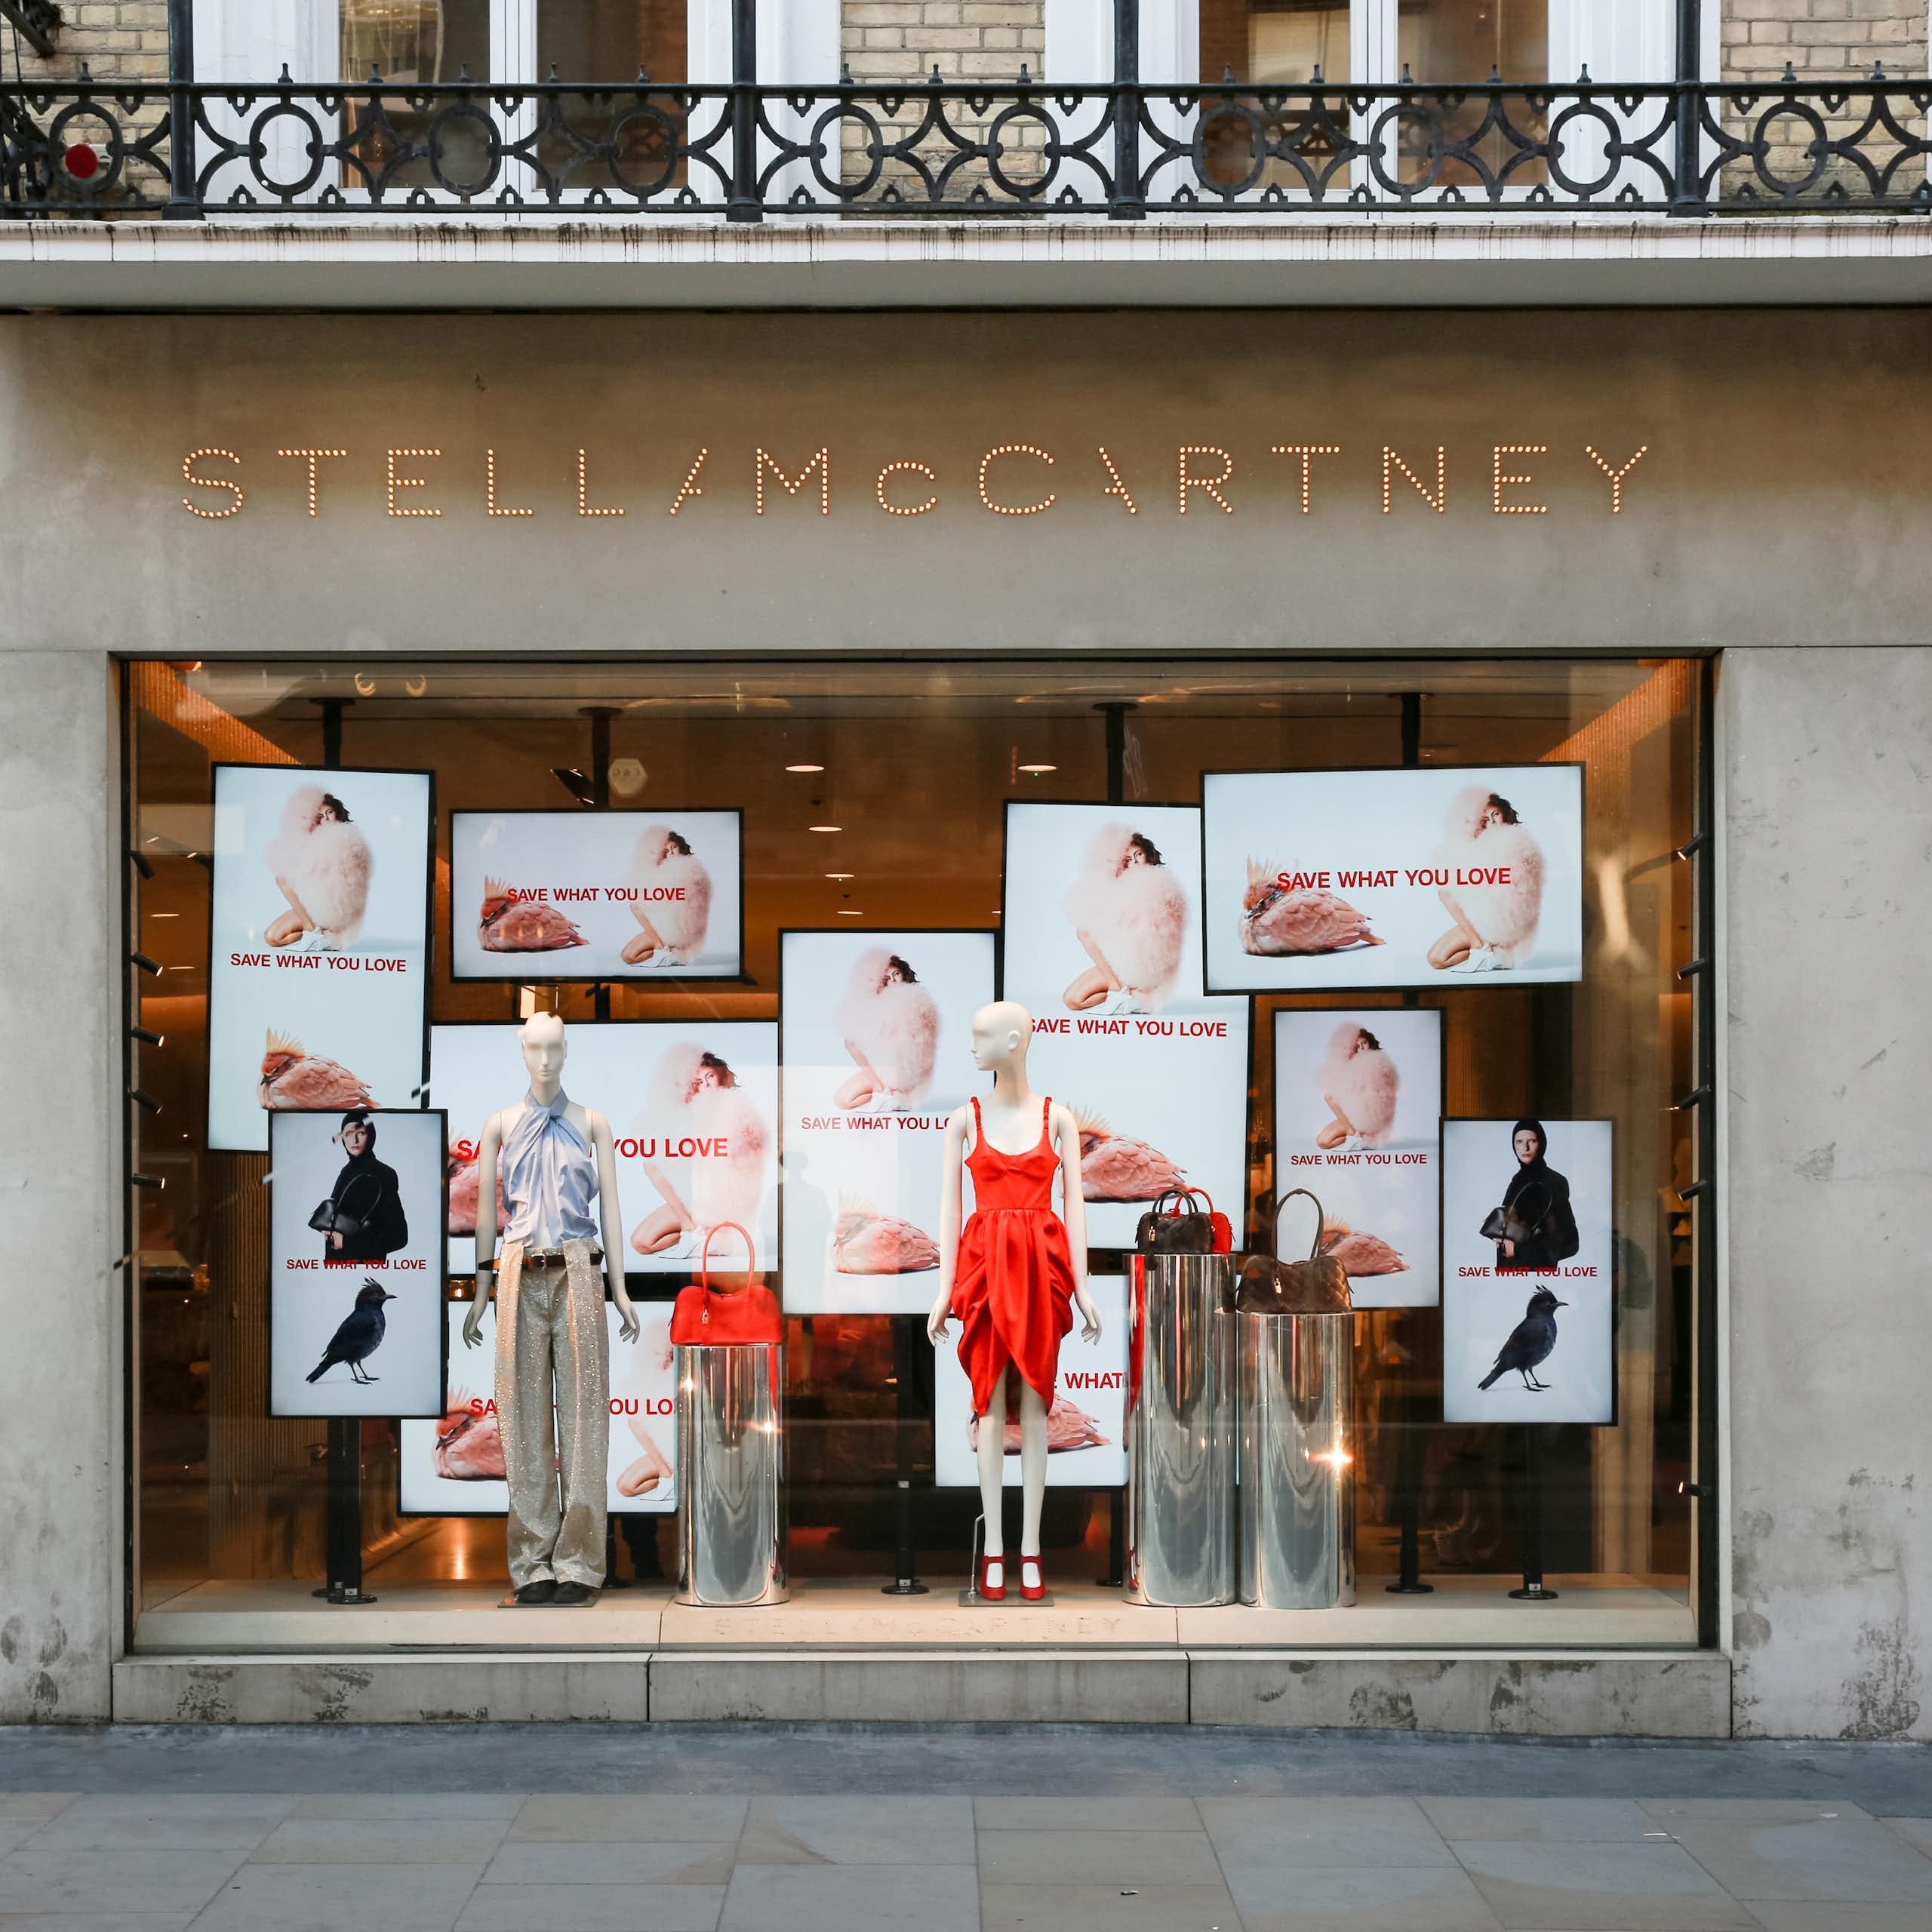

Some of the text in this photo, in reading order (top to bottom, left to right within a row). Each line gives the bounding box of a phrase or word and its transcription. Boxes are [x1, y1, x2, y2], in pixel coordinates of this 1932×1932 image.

[1277, 867, 1511, 889] SAVE WHAT YOU LOVE
[507, 888, 686, 902] SAVE WHAT YOU LOVE
[230, 953, 407, 972] SAVE WHAT YOU LOVE
[1077, 1020, 1130, 1035] WHAT
[1135, 1020, 1173, 1036] YOU
[1180, 1022, 1227, 1037] LOVE
[801, 1117, 841, 1130] SAVE
[847, 1117, 892, 1130] WHAT
[897, 1117, 930, 1130] YOU
[665, 1138, 728, 1158] LOVE
[1291, 1153, 1427, 1165] SAVE WHAT YOU LOVE
[286, 1259, 426, 1269] SAVE WHAT YOU LOVE
[1458, 1266, 1598, 1277] SAVE WHAT YOU LOVE
[1064, 1372, 1123, 1389] WHAT
[470, 1398, 674, 1417] SA OU LO
